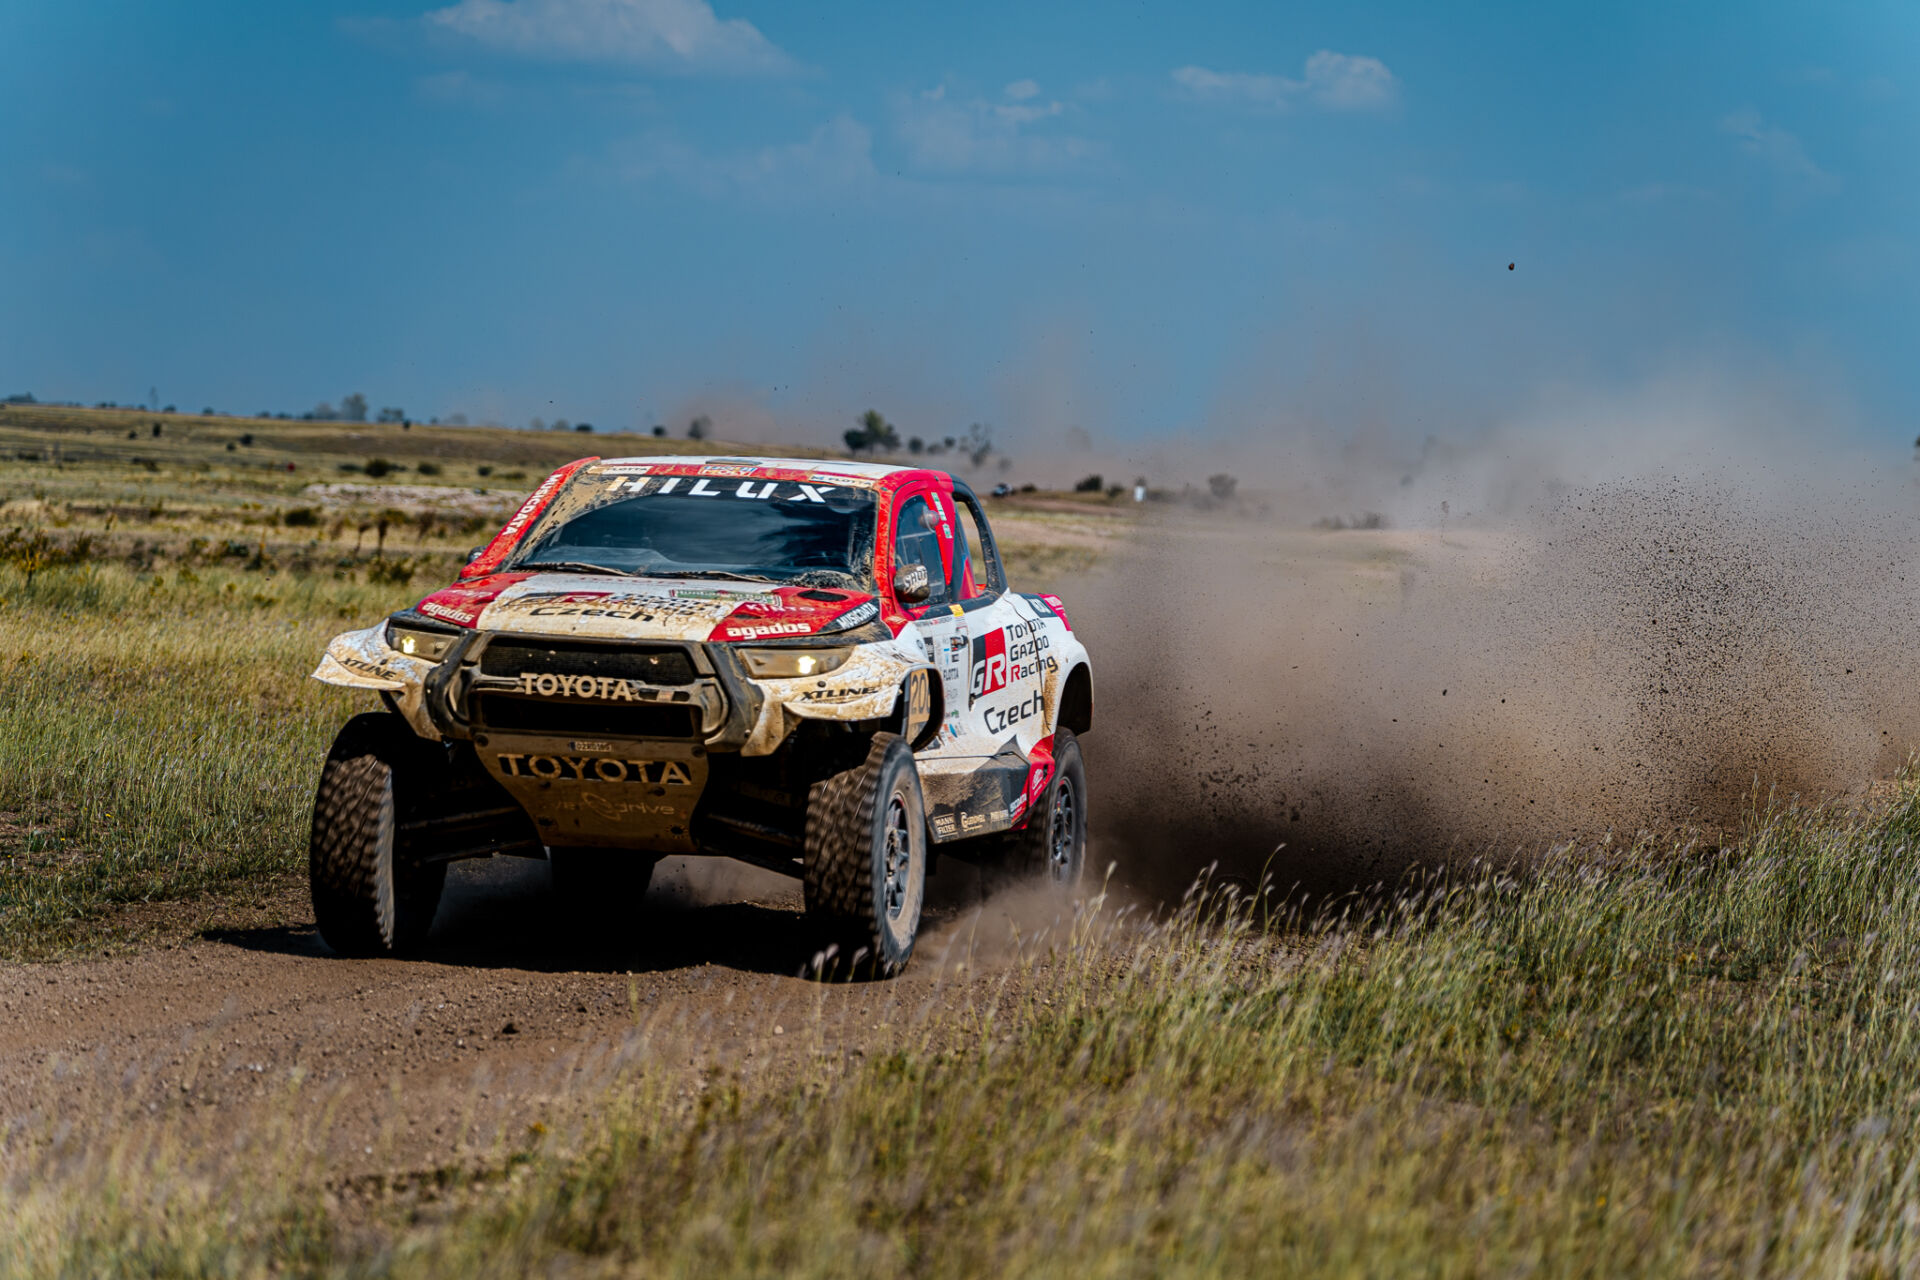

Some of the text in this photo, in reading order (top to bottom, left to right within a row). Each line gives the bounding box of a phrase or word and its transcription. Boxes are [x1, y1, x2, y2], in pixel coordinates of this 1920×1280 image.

[605, 476, 836, 503] HILUX
[502, 474, 562, 535] MUSICDATA
[422, 602, 475, 623] agados
[529, 607, 654, 622] Czech
[836, 602, 879, 629] MUSICDATA
[726, 622, 811, 640] agados
[1006, 618, 1047, 641] TOYOTA
[1010, 635, 1050, 662] GAZOO
[1011, 656, 1058, 682] Racing
[520, 673, 633, 701] TOYOTA
[800, 687, 879, 701] XTLINE
[984, 690, 1045, 734] Czech
[497, 754, 692, 785] TOYOTA
